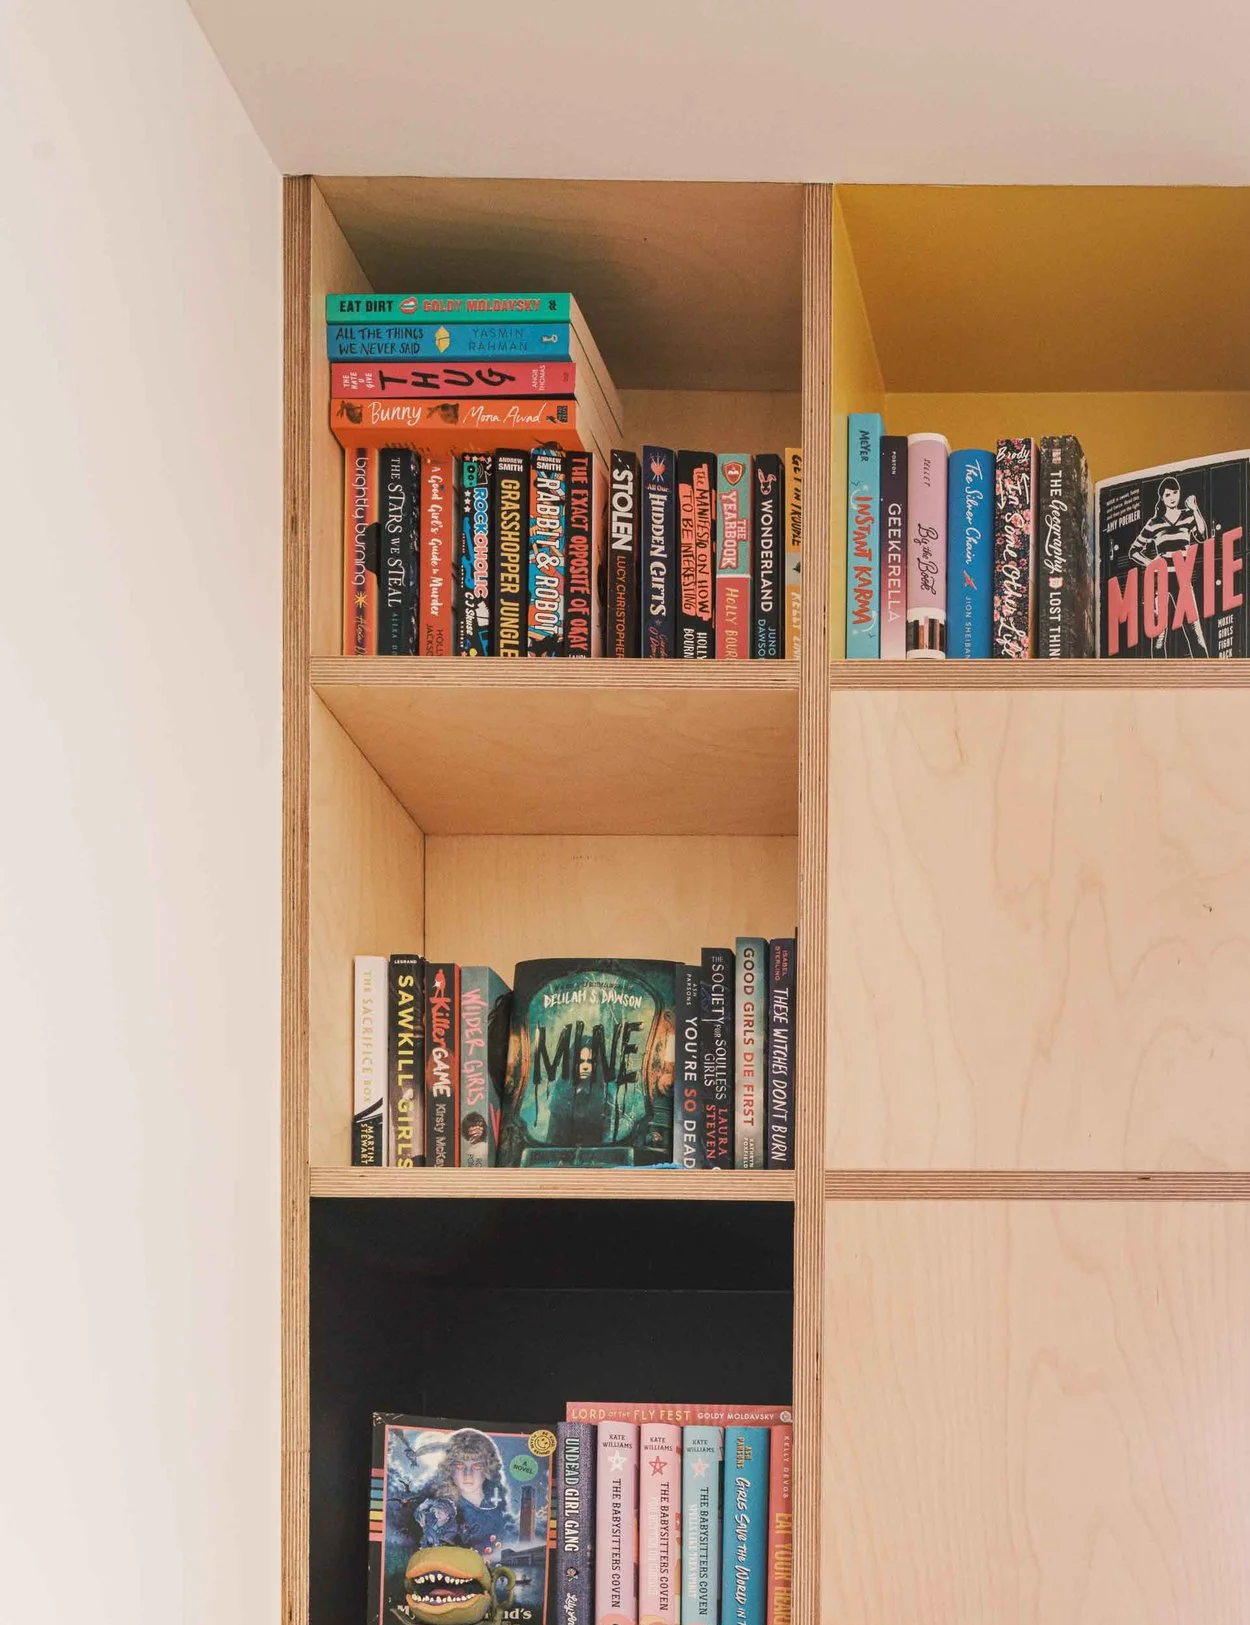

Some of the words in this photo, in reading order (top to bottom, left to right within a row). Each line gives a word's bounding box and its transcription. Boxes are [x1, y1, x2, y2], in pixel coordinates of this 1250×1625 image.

[340, 301, 360, 312] EAT
[366, 300, 393, 312] DIRT
[423, 299, 461, 312] GOLDY
[466, 298, 541, 312] MOLDAVSKY
[336, 327, 355, 340] ALL
[359, 327, 382, 340] THE
[386, 326, 423, 340] THINGS
[339, 342, 356, 354] WE
[359, 341, 395, 355] NEVER
[400, 340, 420, 353] SAID
[468, 341, 528, 352] RAHMAN
[472, 328, 525, 338] YASMIN
[379, 367, 516, 391] THUG
[368, 401, 422, 425] Bunny
[463, 405, 499, 424] Mona
[498, 456, 523, 464] ANDREW
[859, 430, 872, 462] MEYER
[996, 444, 1030, 464] Brody
[391, 457, 401, 480] THE
[498, 463, 523, 472] SMITH
[536, 462, 562, 471] SMITH
[571, 457, 588, 484] THE
[965, 459, 983, 484] The
[1050, 470, 1062, 497] THE
[352, 457, 370, 519] brightly
[428, 475, 443, 500] Good
[682, 490, 693, 513] TO
[965, 486, 984, 526] Silver
[385, 482, 406, 534] STARS
[536, 477, 560, 549] RABBIT
[571, 489, 589, 532] EXACT
[611, 469, 633, 551] STOLEN
[648, 492, 668, 558] HIDDEN
[695, 488, 710, 549] MANIFESTO
[390, 537, 400, 554] WE
[473, 487, 489, 599] ROCKOHOLIC
[500, 479, 520, 594] GRASSHOPPER
[682, 517, 693, 539] BE
[720, 490, 738, 569] YEARBOOK
[737, 519, 747, 540] THE
[853, 496, 875, 562] INSTANT
[965, 527, 982, 565] Chain
[1002, 512, 1024, 561] Some
[1043, 499, 1068, 574] Geography
[351, 522, 369, 586] burning
[428, 538, 443, 566] Guide
[568, 535, 590, 595] OPPOSITE
[616, 556, 626, 582] LUCY
[697, 555, 710, 575] ON
[760, 499, 773, 612] WONDERLAND
[888, 503, 902, 623] GEEKERELLA
[387, 557, 407, 608] STEAL
[649, 561, 667, 617] GIFTS
[681, 543, 697, 610] INTERESTING
[852, 565, 874, 625] KARMA
[917, 558, 939, 595] Book
[1002, 564, 1023, 617] Other
[1108, 526, 1243, 657] MOXIE
[429, 576, 444, 617] Murder
[534, 575, 559, 634] ROBOT
[568, 598, 590, 616] OF
[697, 580, 710, 614] HOW
[1048, 592, 1062, 622] LOST
[500, 598, 520, 657] JUNGLE
[568, 618, 589, 651] OKAY
[1218, 613, 1234, 628] MOXIE
[1218, 625, 1234, 639] GIRLS
[768, 628, 776, 656] JUNO
[1218, 636, 1233, 651] FIGHT
[743, 947, 755, 995] GOOD
[543, 989, 587, 1008] DELILAH
[601, 989, 643, 1008] DAWSON
[773, 987, 789, 1024] THESE
[361, 997, 373, 1075] SACRIFICE
[398, 975, 414, 1087] SAWKILL
[429, 997, 452, 1049] Killer
[461, 987, 489, 1056] WILDER
[701, 963, 725, 1025] SOCIETY
[715, 1039, 727, 1100] SOULLESS
[743, 1001, 755, 1045] GIRLS
[533, 1020, 644, 1086] MINE
[684, 1016, 698, 1081] YOU'RE
[743, 1052, 755, 1077] DIE
[772, 1028, 789, 1076] WITCHES
[431, 1047, 452, 1098] GAME
[463, 1059, 485, 1106] GIRLS
[703, 1053, 715, 1087] GIRLS
[434, 1103, 447, 1133] Kirsty
[683, 1088, 697, 1113] SO
[743, 1084, 754, 1126] FIRST
[771, 1079, 788, 1122] DON'T
[360, 1123, 368, 1165] STEWART
[366, 1124, 375, 1163] MARTIN
[397, 1098, 414, 1168] GIRLS
[683, 1120, 697, 1169] DEAD
[718, 1107, 728, 1156] LAURA
[771, 1125, 788, 1162] BURN
[571, 1409, 606, 1419] LORD
[634, 1410, 656, 1420] FLY
[660, 1410, 691, 1421] FEST
[697, 1412, 724, 1420] GOLDY
[564, 1436, 580, 1485] UNDEAD
[602, 1441, 633, 1449] WILLIAMS
[512, 1464, 533, 1475] NOVEL
[564, 1488, 580, 1521] GIRL
[612, 1478, 621, 1500] THE
[660, 1481, 669, 1503] THE
[700, 1486, 709, 1508] THE
[564, 1523, 580, 1552] GANG
[611, 1502, 621, 1571] BABYSITTERS
[659, 1504, 670, 1574] BABYSITTERS
[699, 1511, 709, 1578] BABYSITTERS
[611, 1574, 621, 1608] COVEN
[659, 1576, 669, 1611] COVEN
[699, 1580, 708, 1615] COVEN
